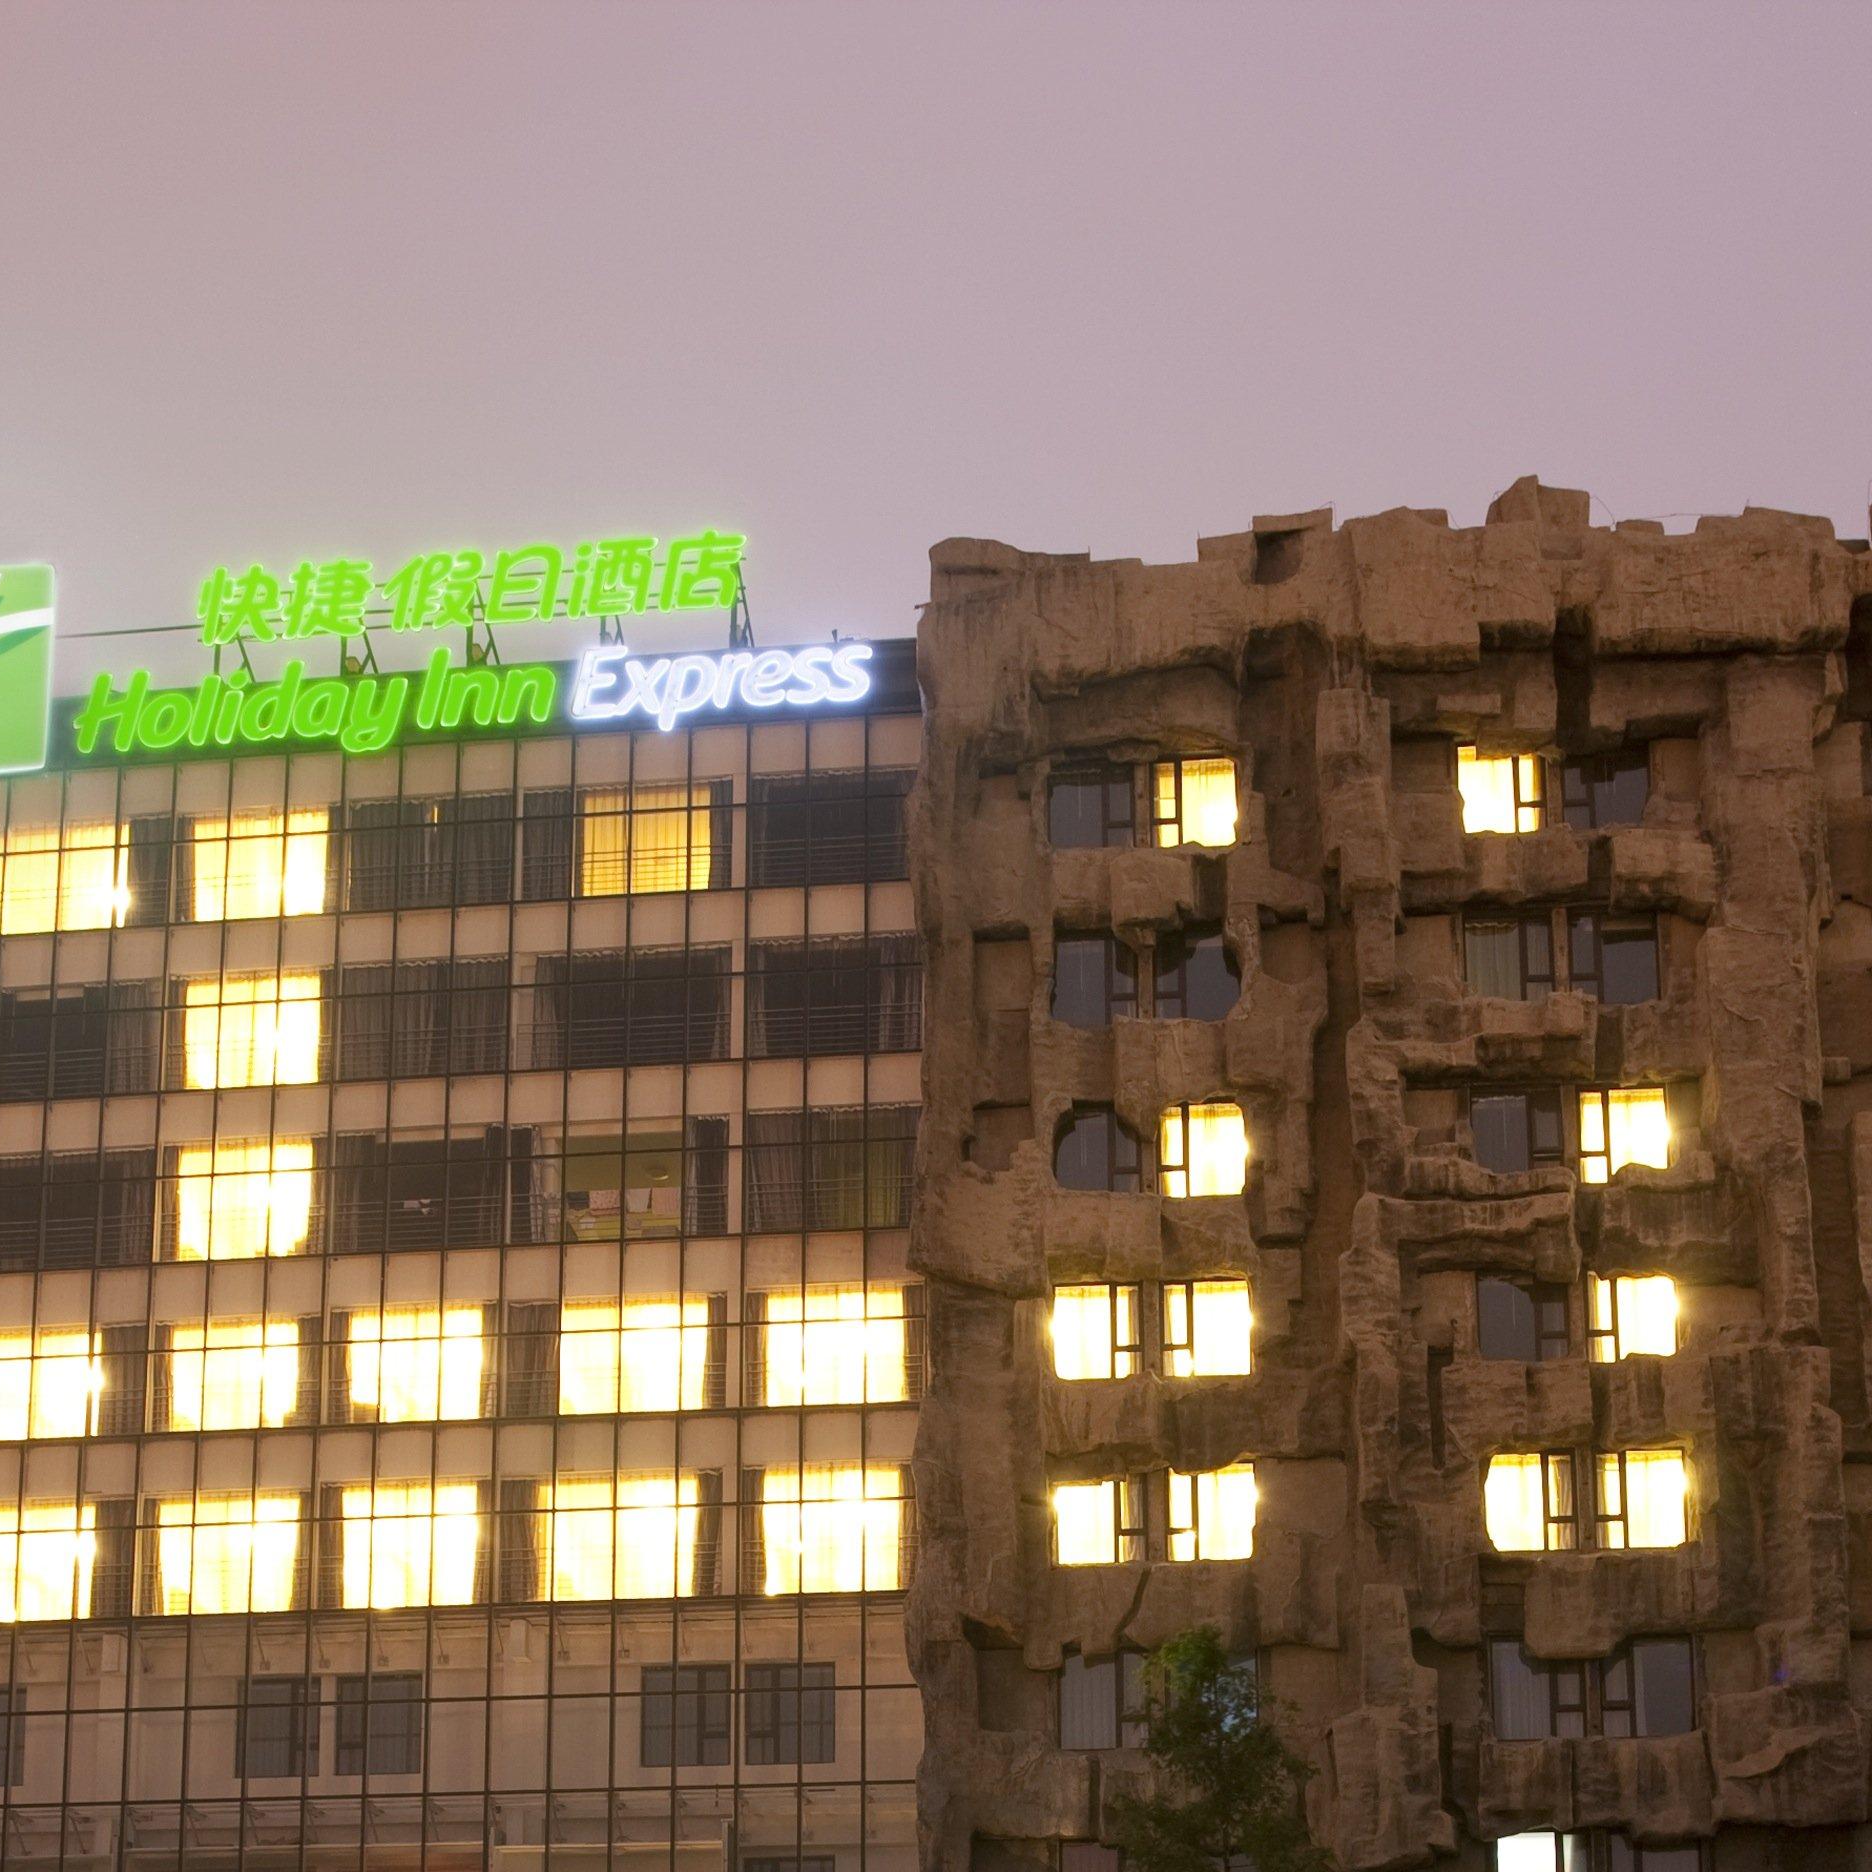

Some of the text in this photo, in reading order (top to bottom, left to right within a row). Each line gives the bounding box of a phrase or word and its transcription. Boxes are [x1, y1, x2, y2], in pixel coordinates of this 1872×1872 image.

[73, 644, 873, 752] Holiday Inn Express
